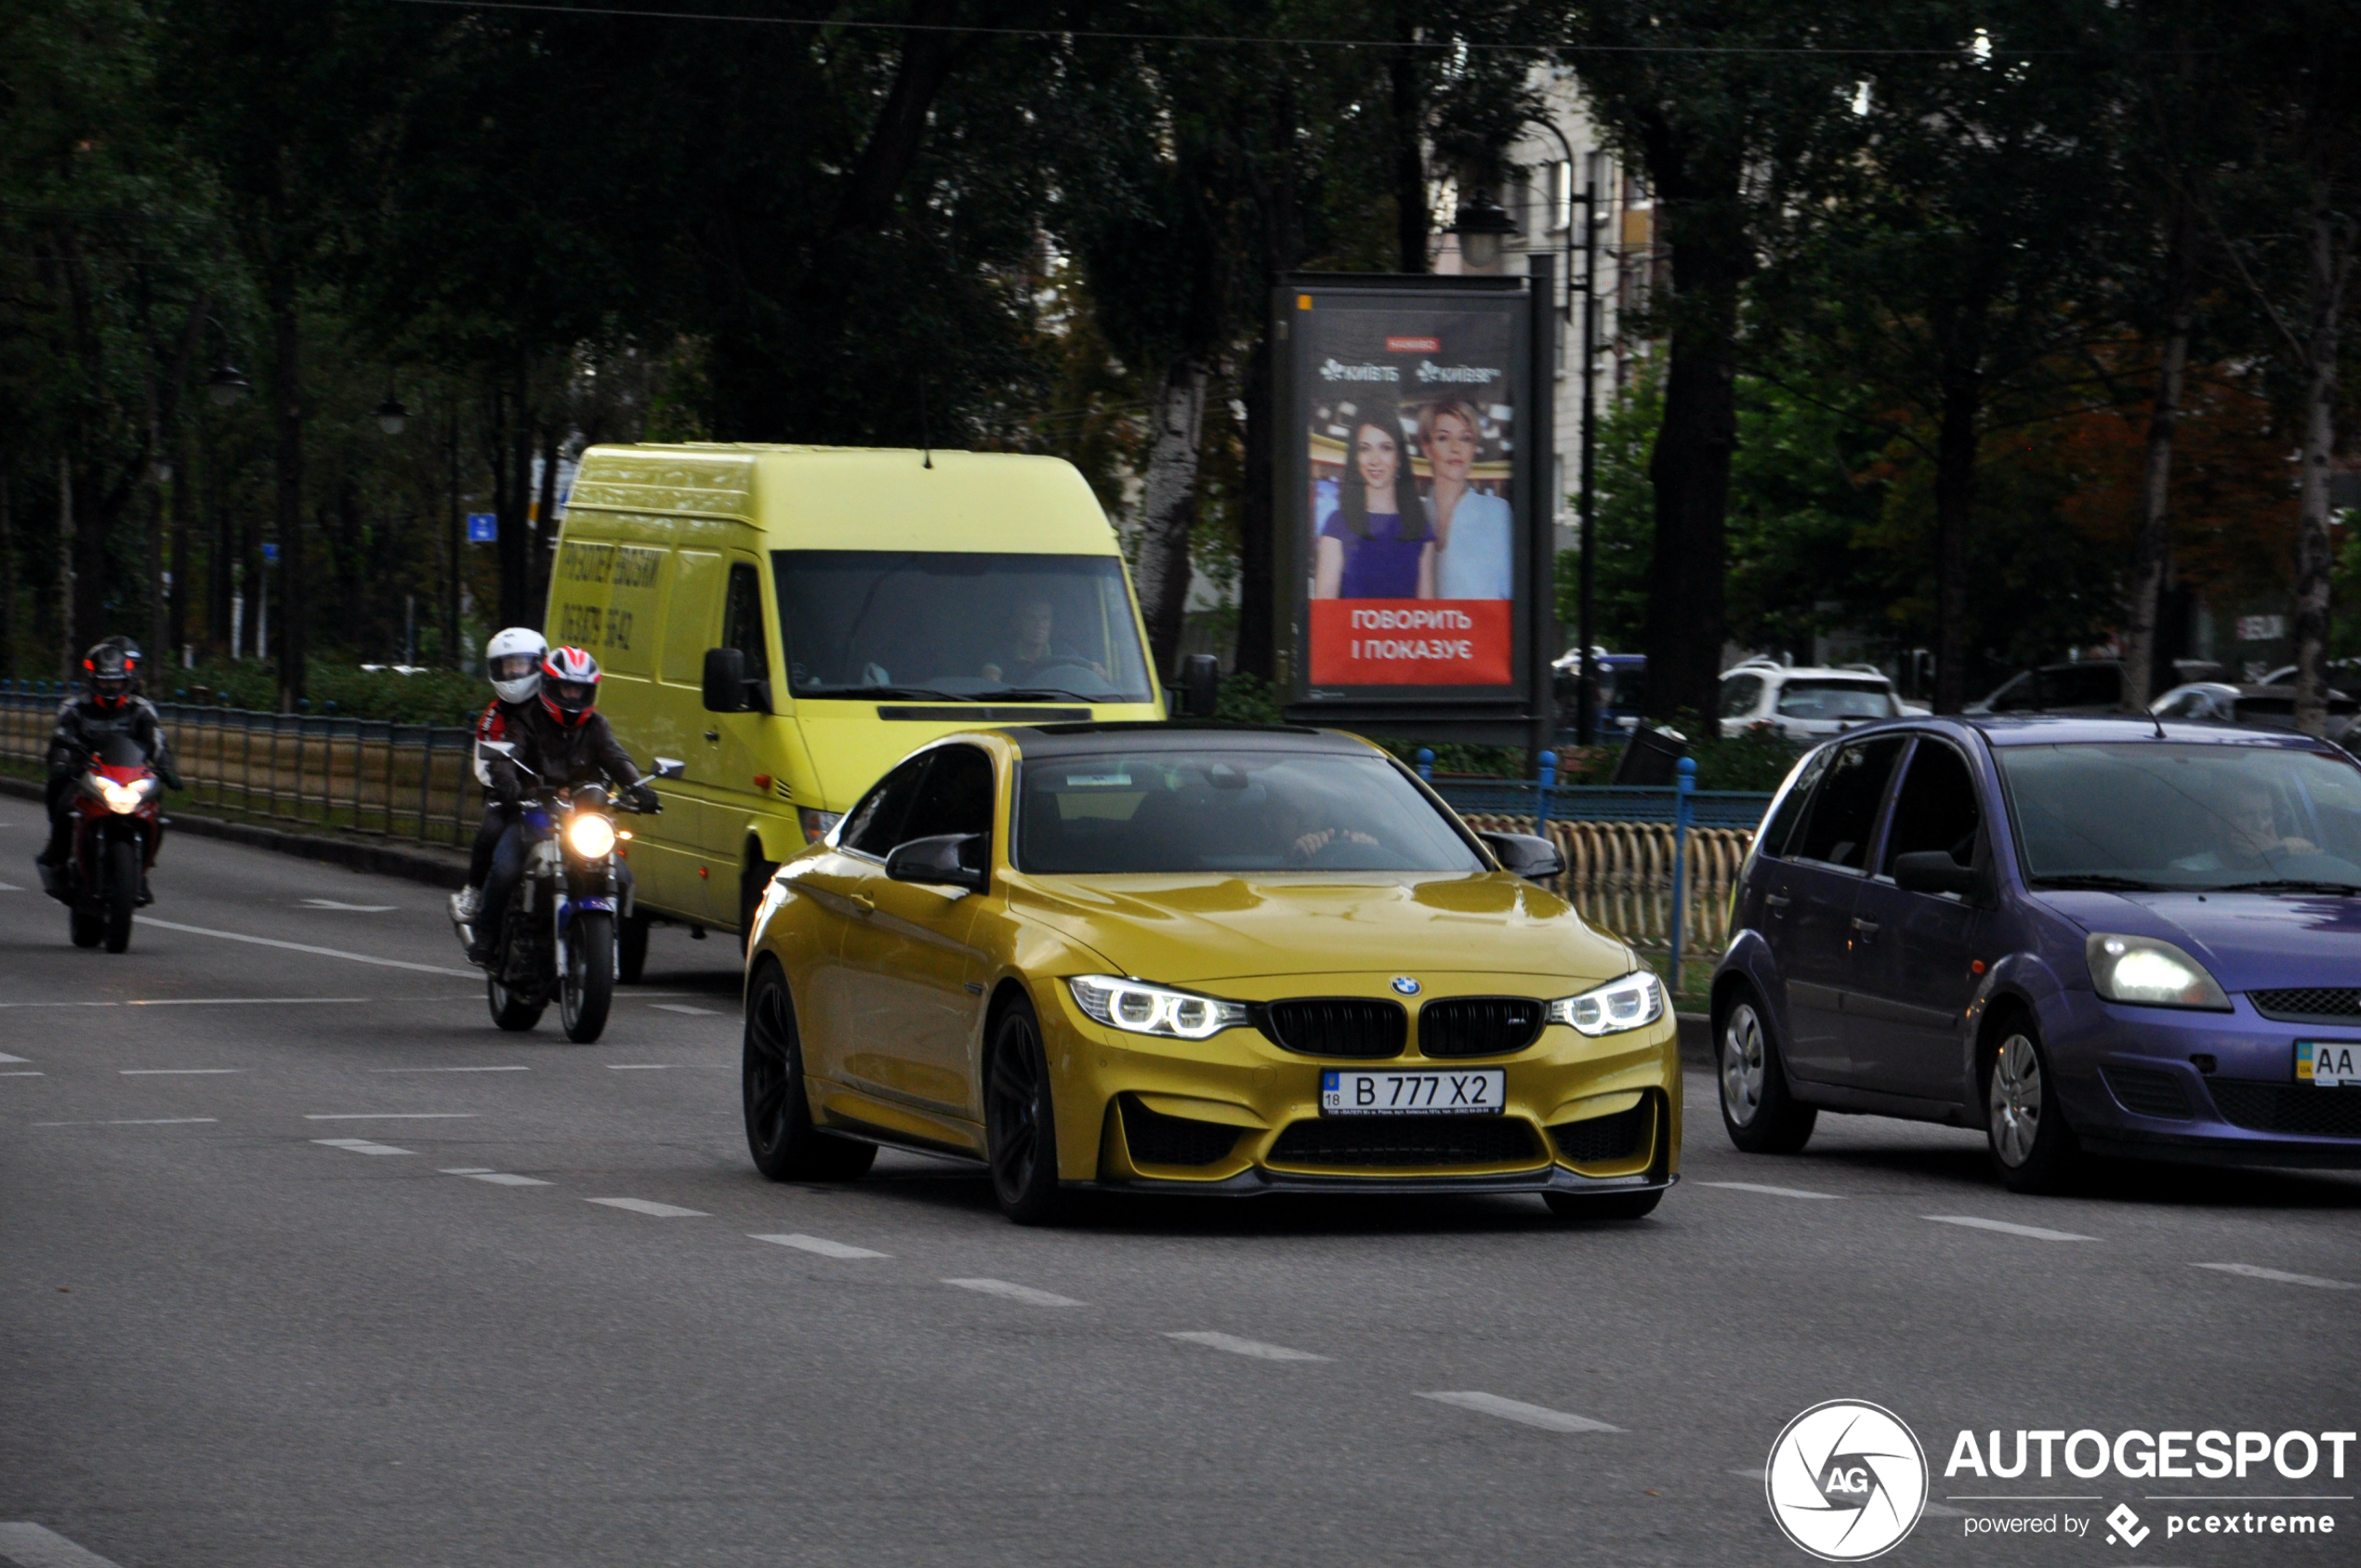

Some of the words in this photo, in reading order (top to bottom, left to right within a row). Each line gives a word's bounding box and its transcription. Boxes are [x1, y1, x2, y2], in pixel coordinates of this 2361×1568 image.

[1351, 609, 1472, 629] ГОВОРИТЬ
[1351, 639, 1360, 659] І
[1364, 639, 1473, 660] ПОКАЗУЄ
[2316, 1048, 2354, 1074] AA
[1325, 1094, 1339, 1106] 18
